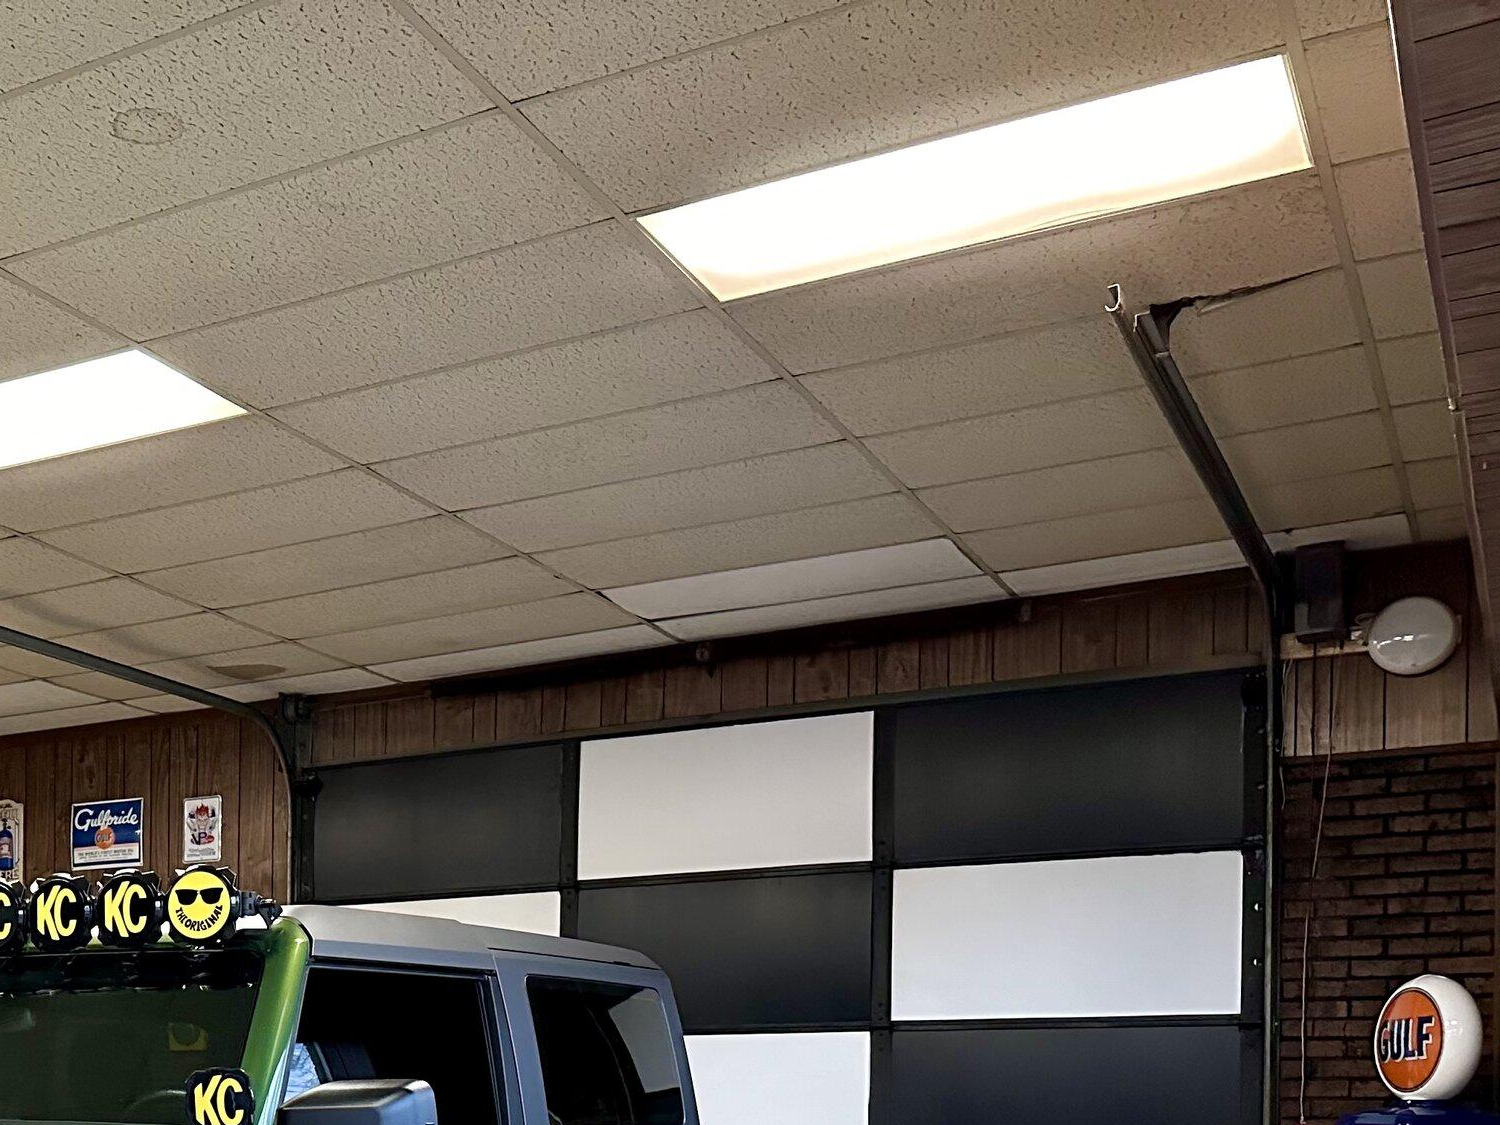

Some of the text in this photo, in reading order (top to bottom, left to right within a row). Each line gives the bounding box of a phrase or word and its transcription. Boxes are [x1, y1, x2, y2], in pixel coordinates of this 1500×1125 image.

[74, 807, 139, 831] Gulfpride
[36, 885, 77, 940] KC
[104, 881, 148, 938] KC
[184, 905, 223, 932] ORIGINAL
[1380, 1015, 1435, 1064] GULF
